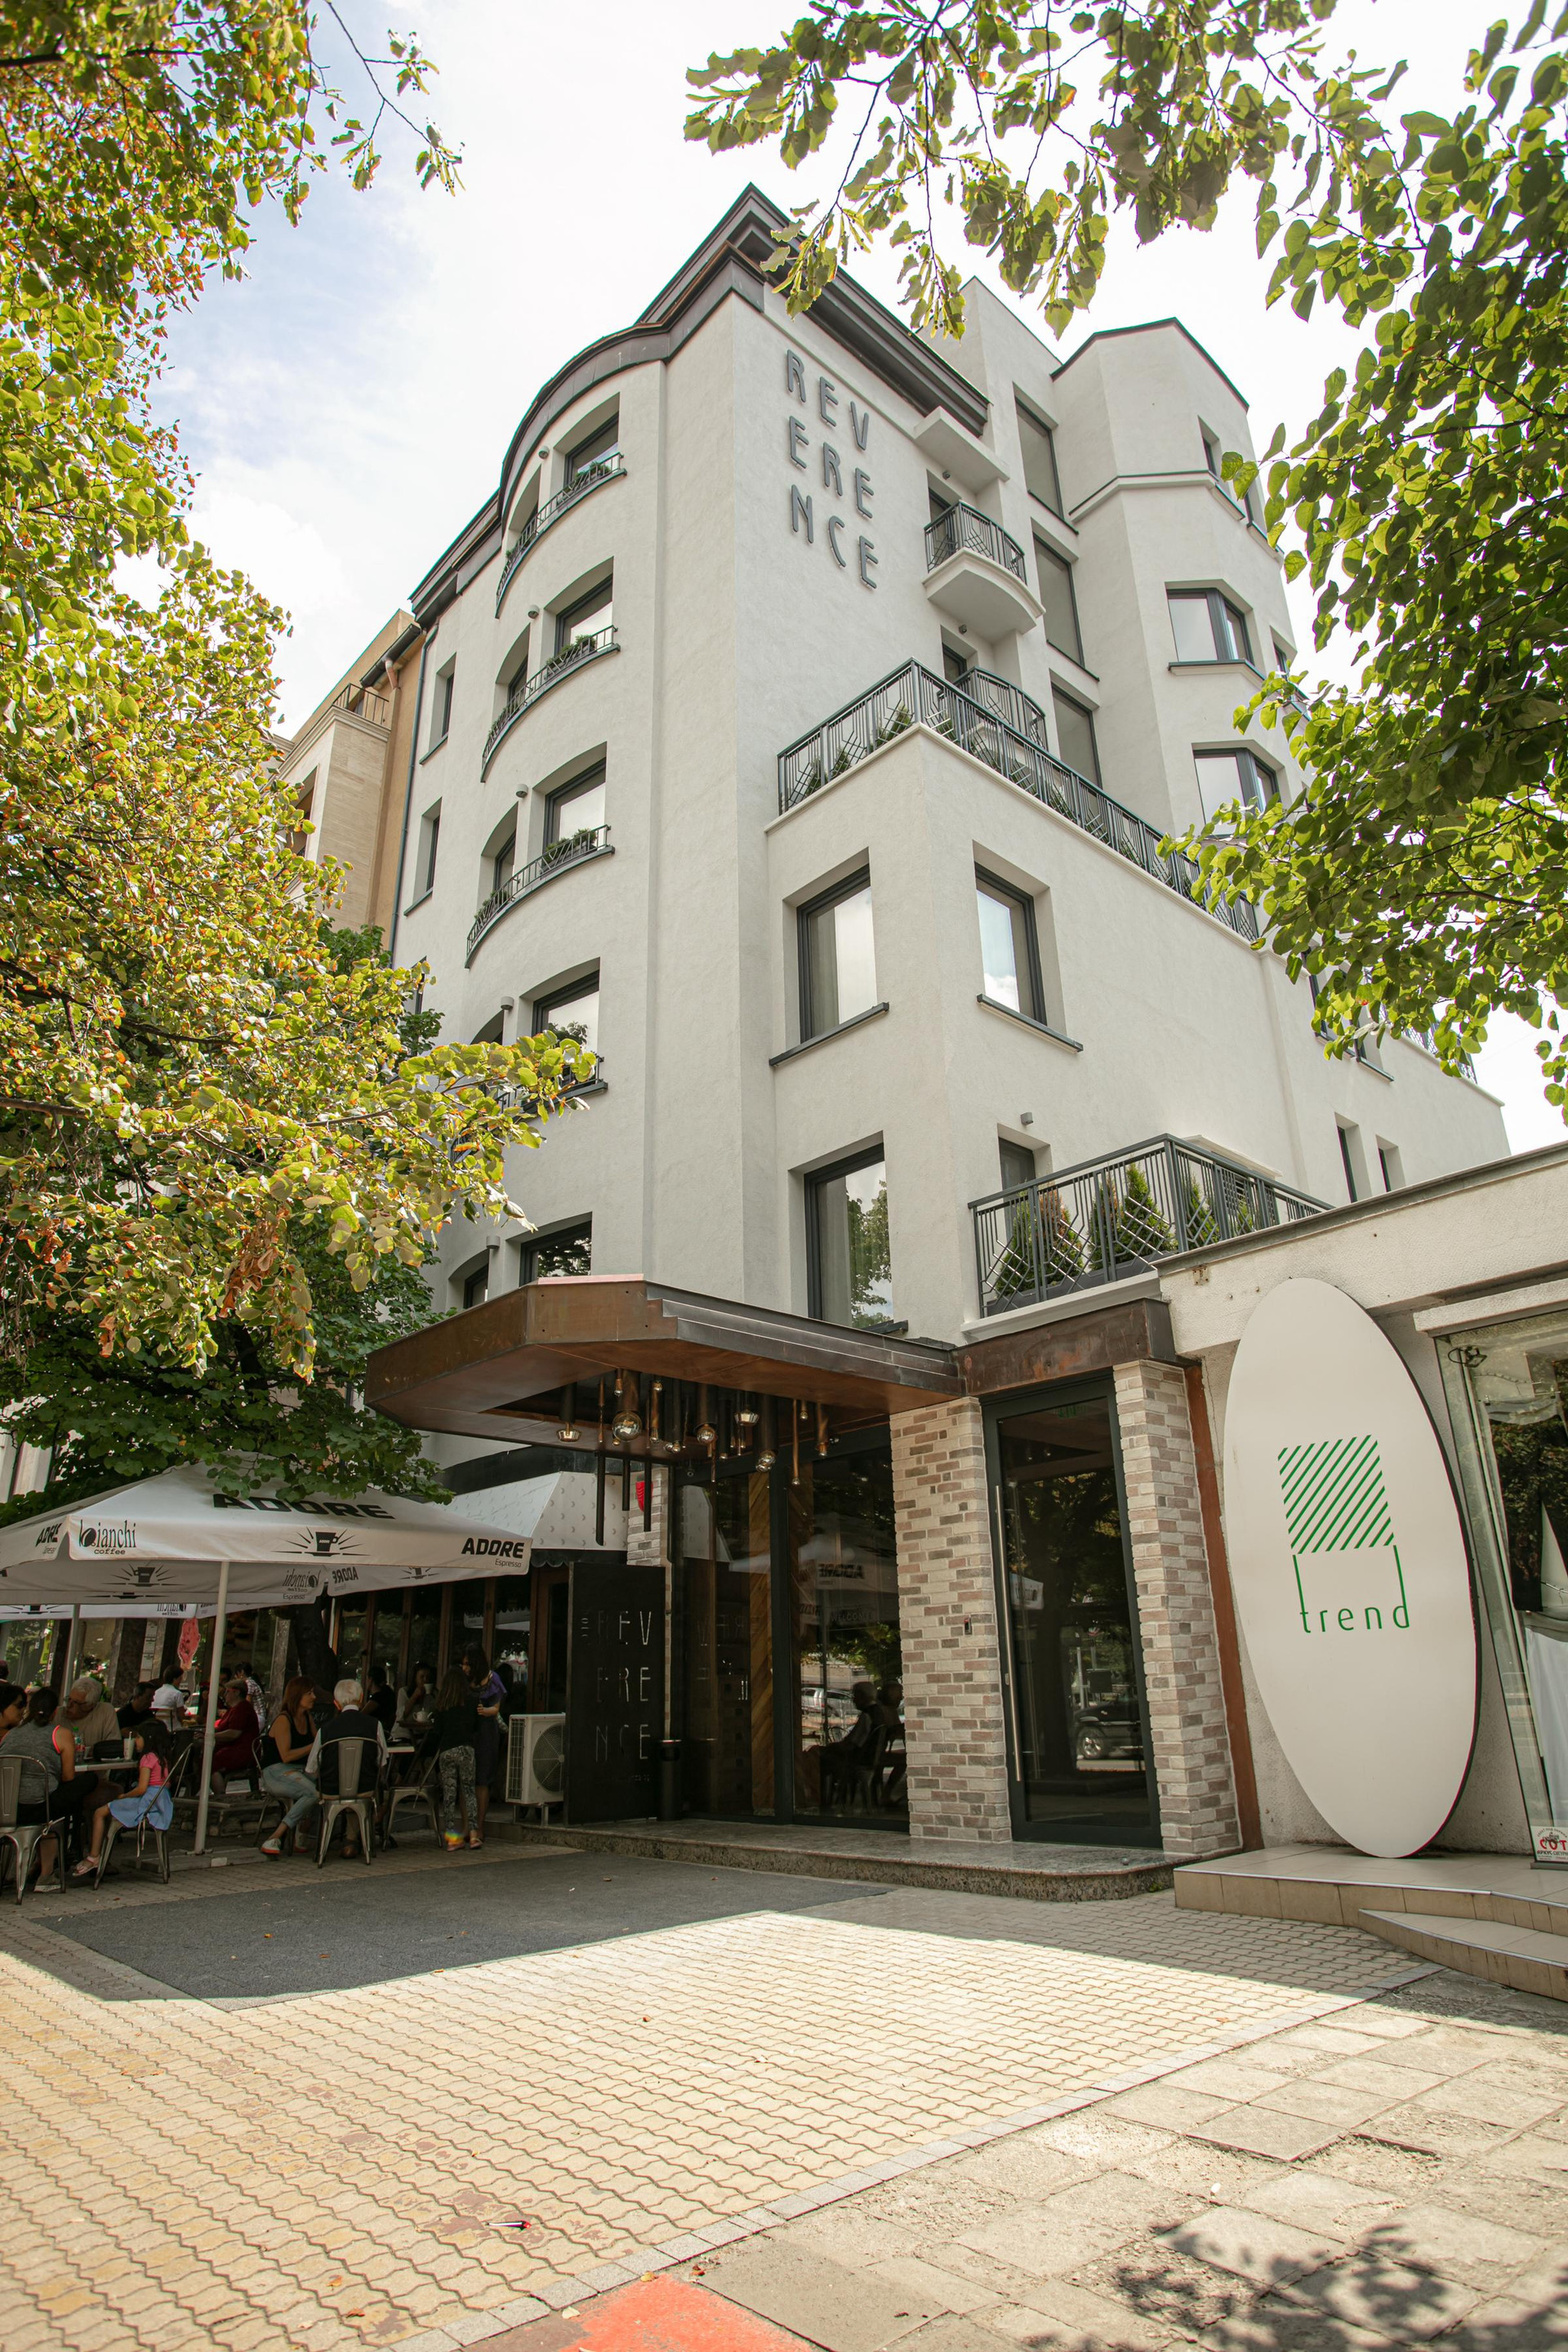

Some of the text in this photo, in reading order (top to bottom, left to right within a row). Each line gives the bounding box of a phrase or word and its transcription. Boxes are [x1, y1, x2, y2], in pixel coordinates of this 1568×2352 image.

[786, 349, 869, 450] REV
[789, 416, 874, 519] ERE
[791, 484, 879, 589] NCE
[79, 1520, 136, 1548] bianchi
[213, 1493, 395, 1520] ADORE
[461, 1537, 524, 1559] ADORE
[495, 1558, 522, 1568] Espresso
[1292, 1544, 1410, 1633] trend
